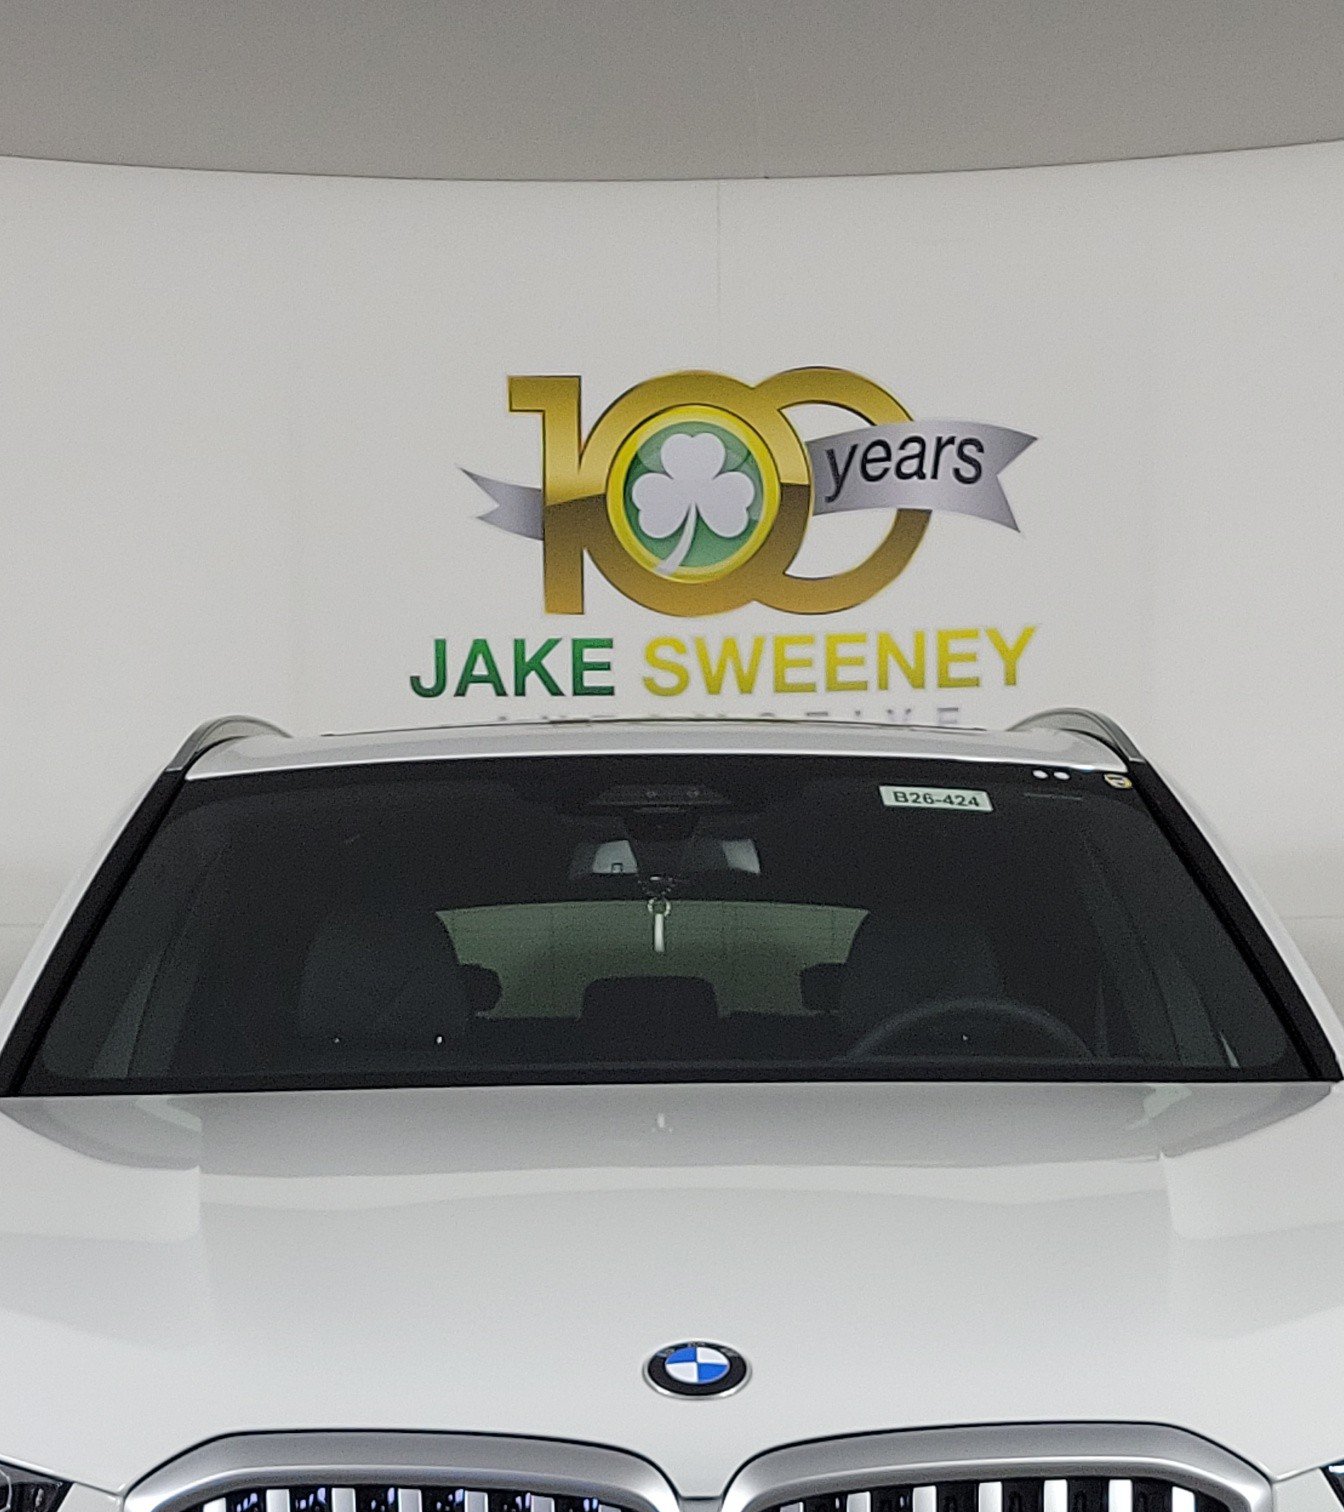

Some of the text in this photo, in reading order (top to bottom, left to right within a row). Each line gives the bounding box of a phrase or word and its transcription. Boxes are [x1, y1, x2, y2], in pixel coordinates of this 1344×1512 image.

[507, 365, 985, 617] 100 years
[410, 626, 1037, 698] JAKE SWEENEY
[892, 790, 981, 808] B26-424
